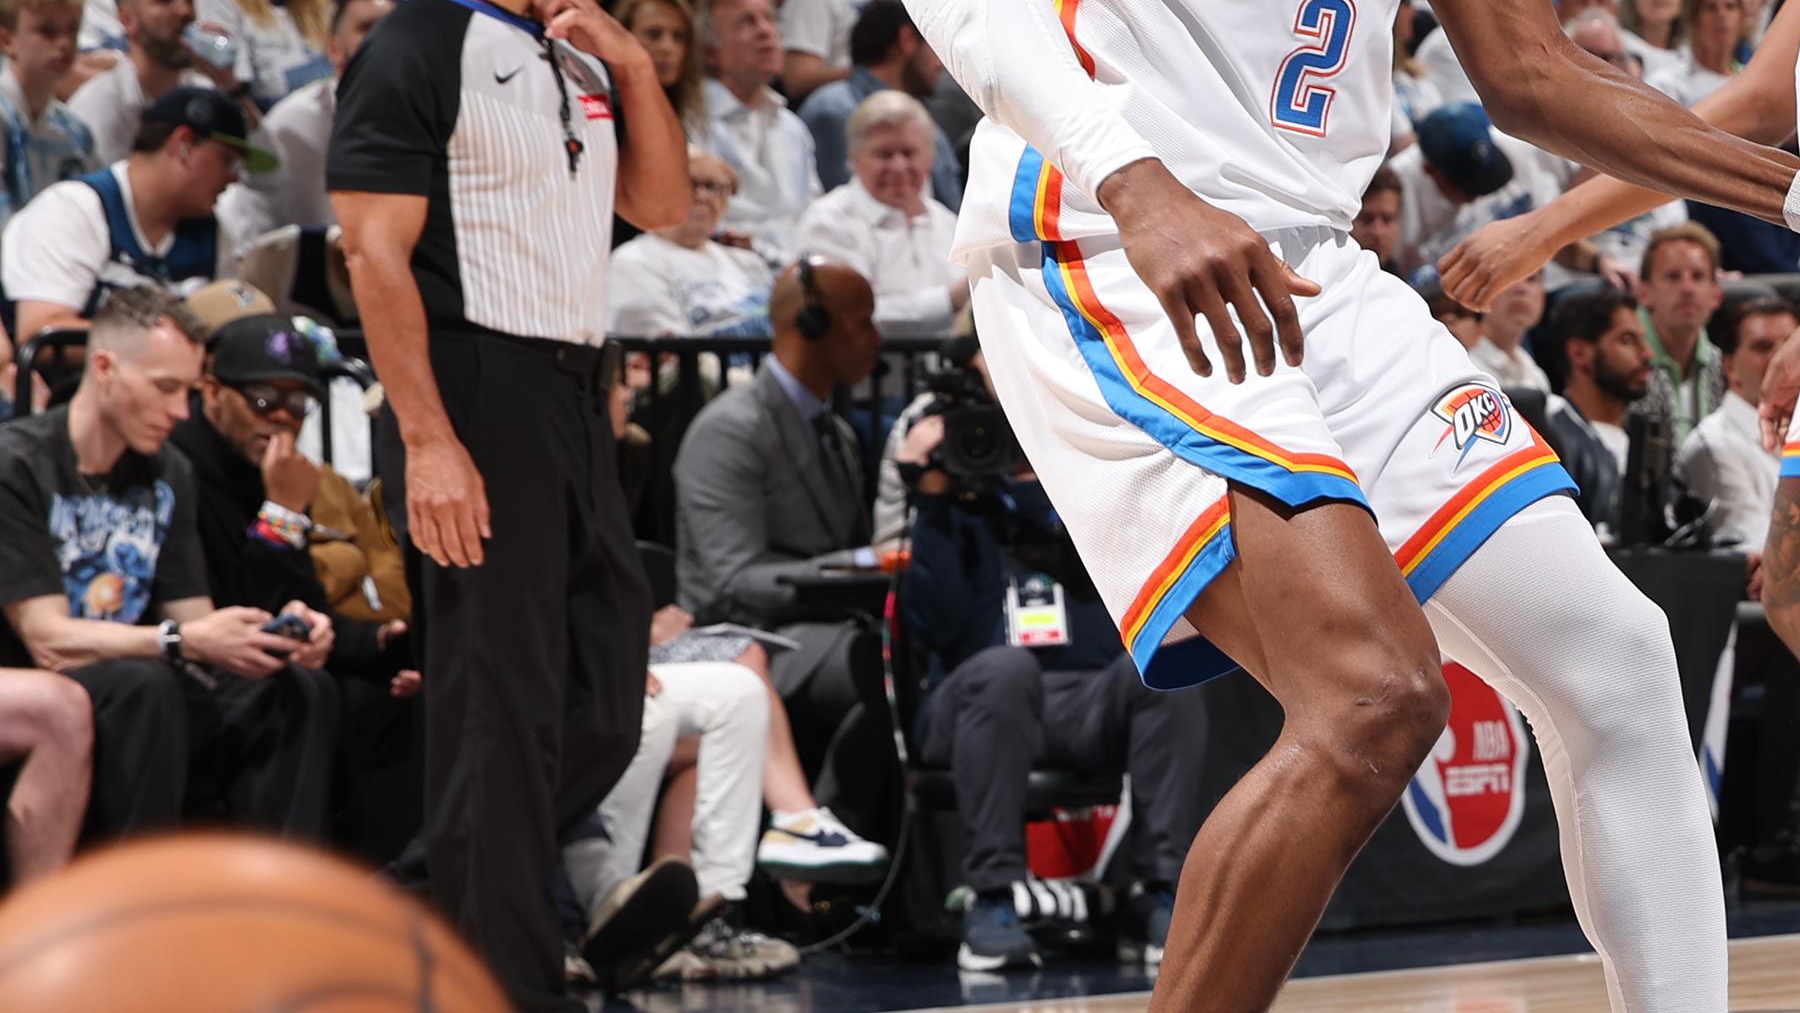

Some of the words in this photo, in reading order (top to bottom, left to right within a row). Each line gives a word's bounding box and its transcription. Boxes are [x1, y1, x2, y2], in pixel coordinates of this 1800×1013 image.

[1454, 391, 1496, 449] OKC
[1472, 719, 1510, 762] NBA
[1444, 762, 1511, 798] ESPN
